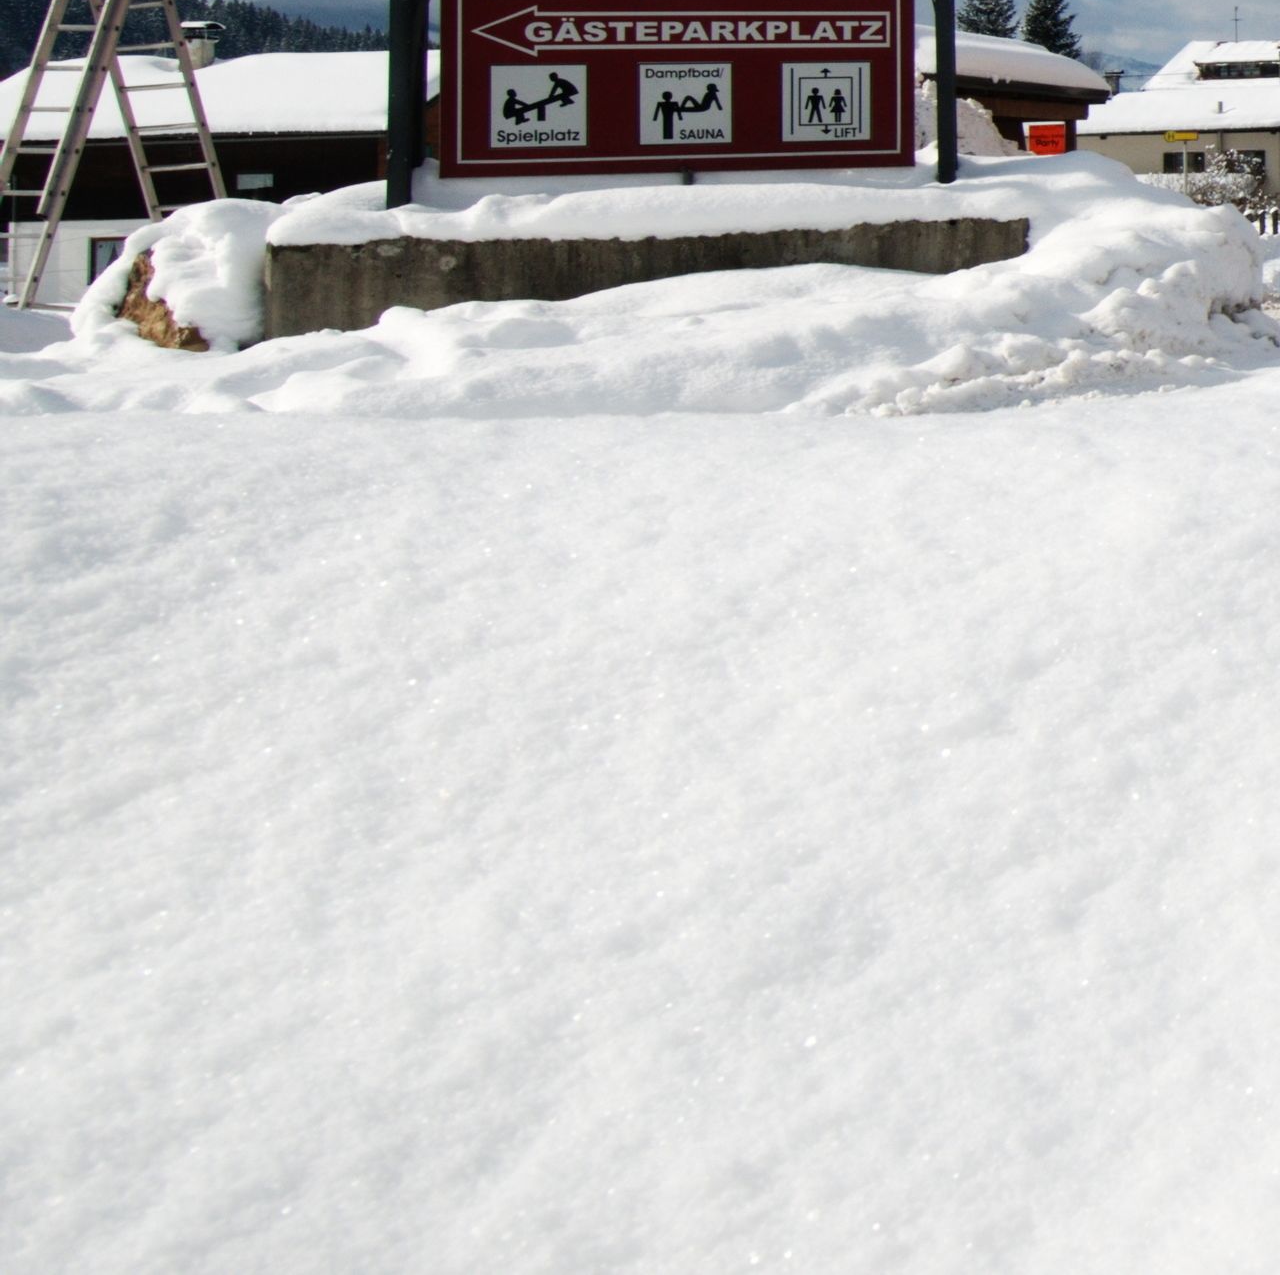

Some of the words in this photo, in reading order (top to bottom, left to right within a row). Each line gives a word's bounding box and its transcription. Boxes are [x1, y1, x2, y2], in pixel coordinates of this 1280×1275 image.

[524, 17, 884, 42] GÄSTEPARKPLATZ
[496, 128, 580, 145] Spielplatz
[679, 129, 725, 140] SAUNA
[834, 127, 857, 138] LIFT
[1035, 138, 1059, 147] Party
